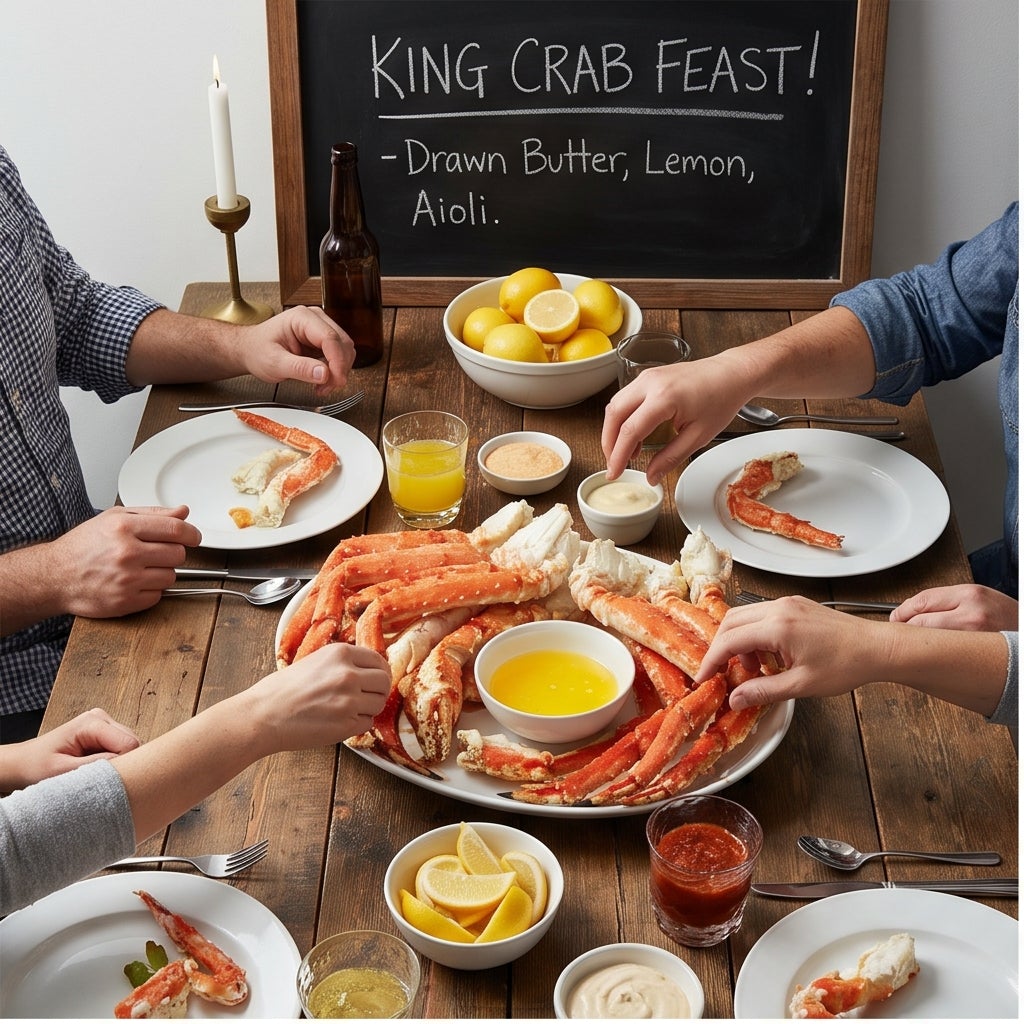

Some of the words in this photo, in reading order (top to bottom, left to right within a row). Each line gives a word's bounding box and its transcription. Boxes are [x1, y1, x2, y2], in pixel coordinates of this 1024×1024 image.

[371, 34, 489, 100] KING
[511, 37, 633, 95] CRAB
[655, 30, 820, 96] FEAST!
[521, 137, 629, 182] Butter,
[645, 139, 754, 184] Lemon,
[412, 189, 499, 227] Aioli.
